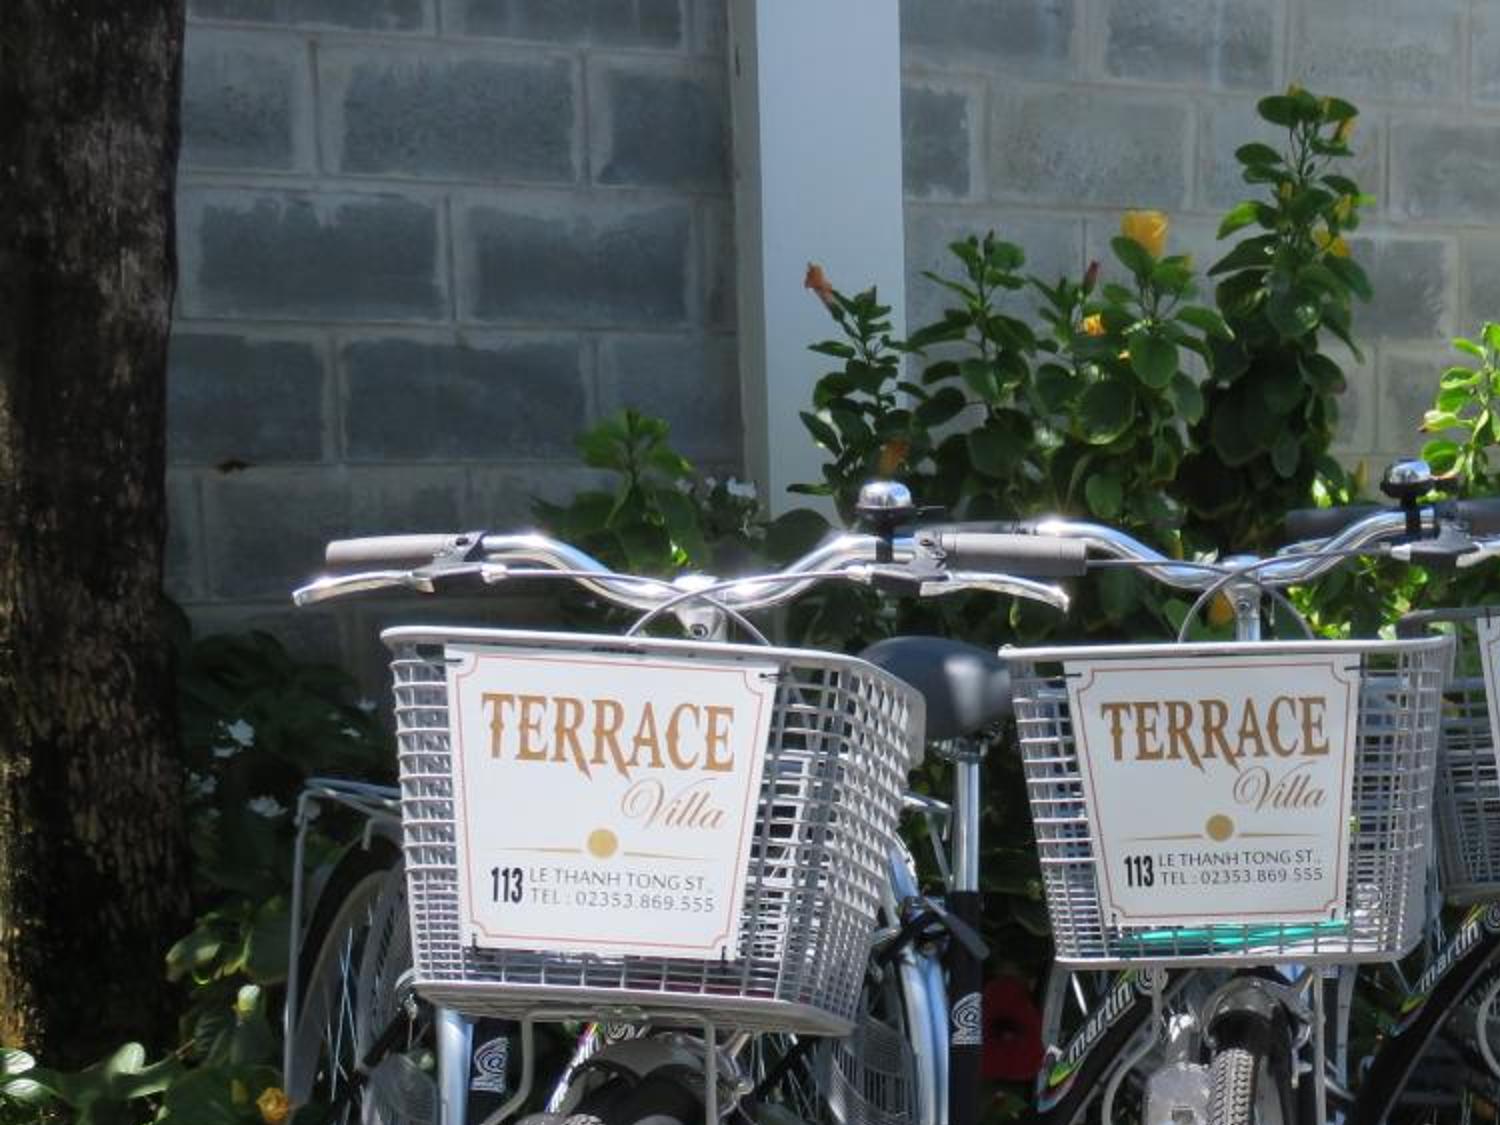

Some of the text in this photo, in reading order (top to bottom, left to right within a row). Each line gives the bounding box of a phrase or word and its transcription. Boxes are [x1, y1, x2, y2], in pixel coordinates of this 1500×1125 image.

[481, 692, 735, 782] TERRACE
[1101, 695, 1330, 773] TERRACE
[621, 777, 727, 829] Villa
[1233, 760, 1327, 812] Villa
[491, 867, 523, 904] 113
[530, 867, 548, 882] LE
[555, 868, 620, 887] THANH
[626, 872, 680, 891] TONG
[1124, 855, 1154, 888] 113
[1159, 854, 1175, 867] LE
[1179, 852, 1239, 866] THANH
[1244, 850, 1291, 865] TONG
[1200, 867, 1323, 885] 02353.869.555
[575, 891, 715, 913] 02353.869.555
[1420, 920, 1479, 993] martin
[1068, 981, 1132, 1064] martin
